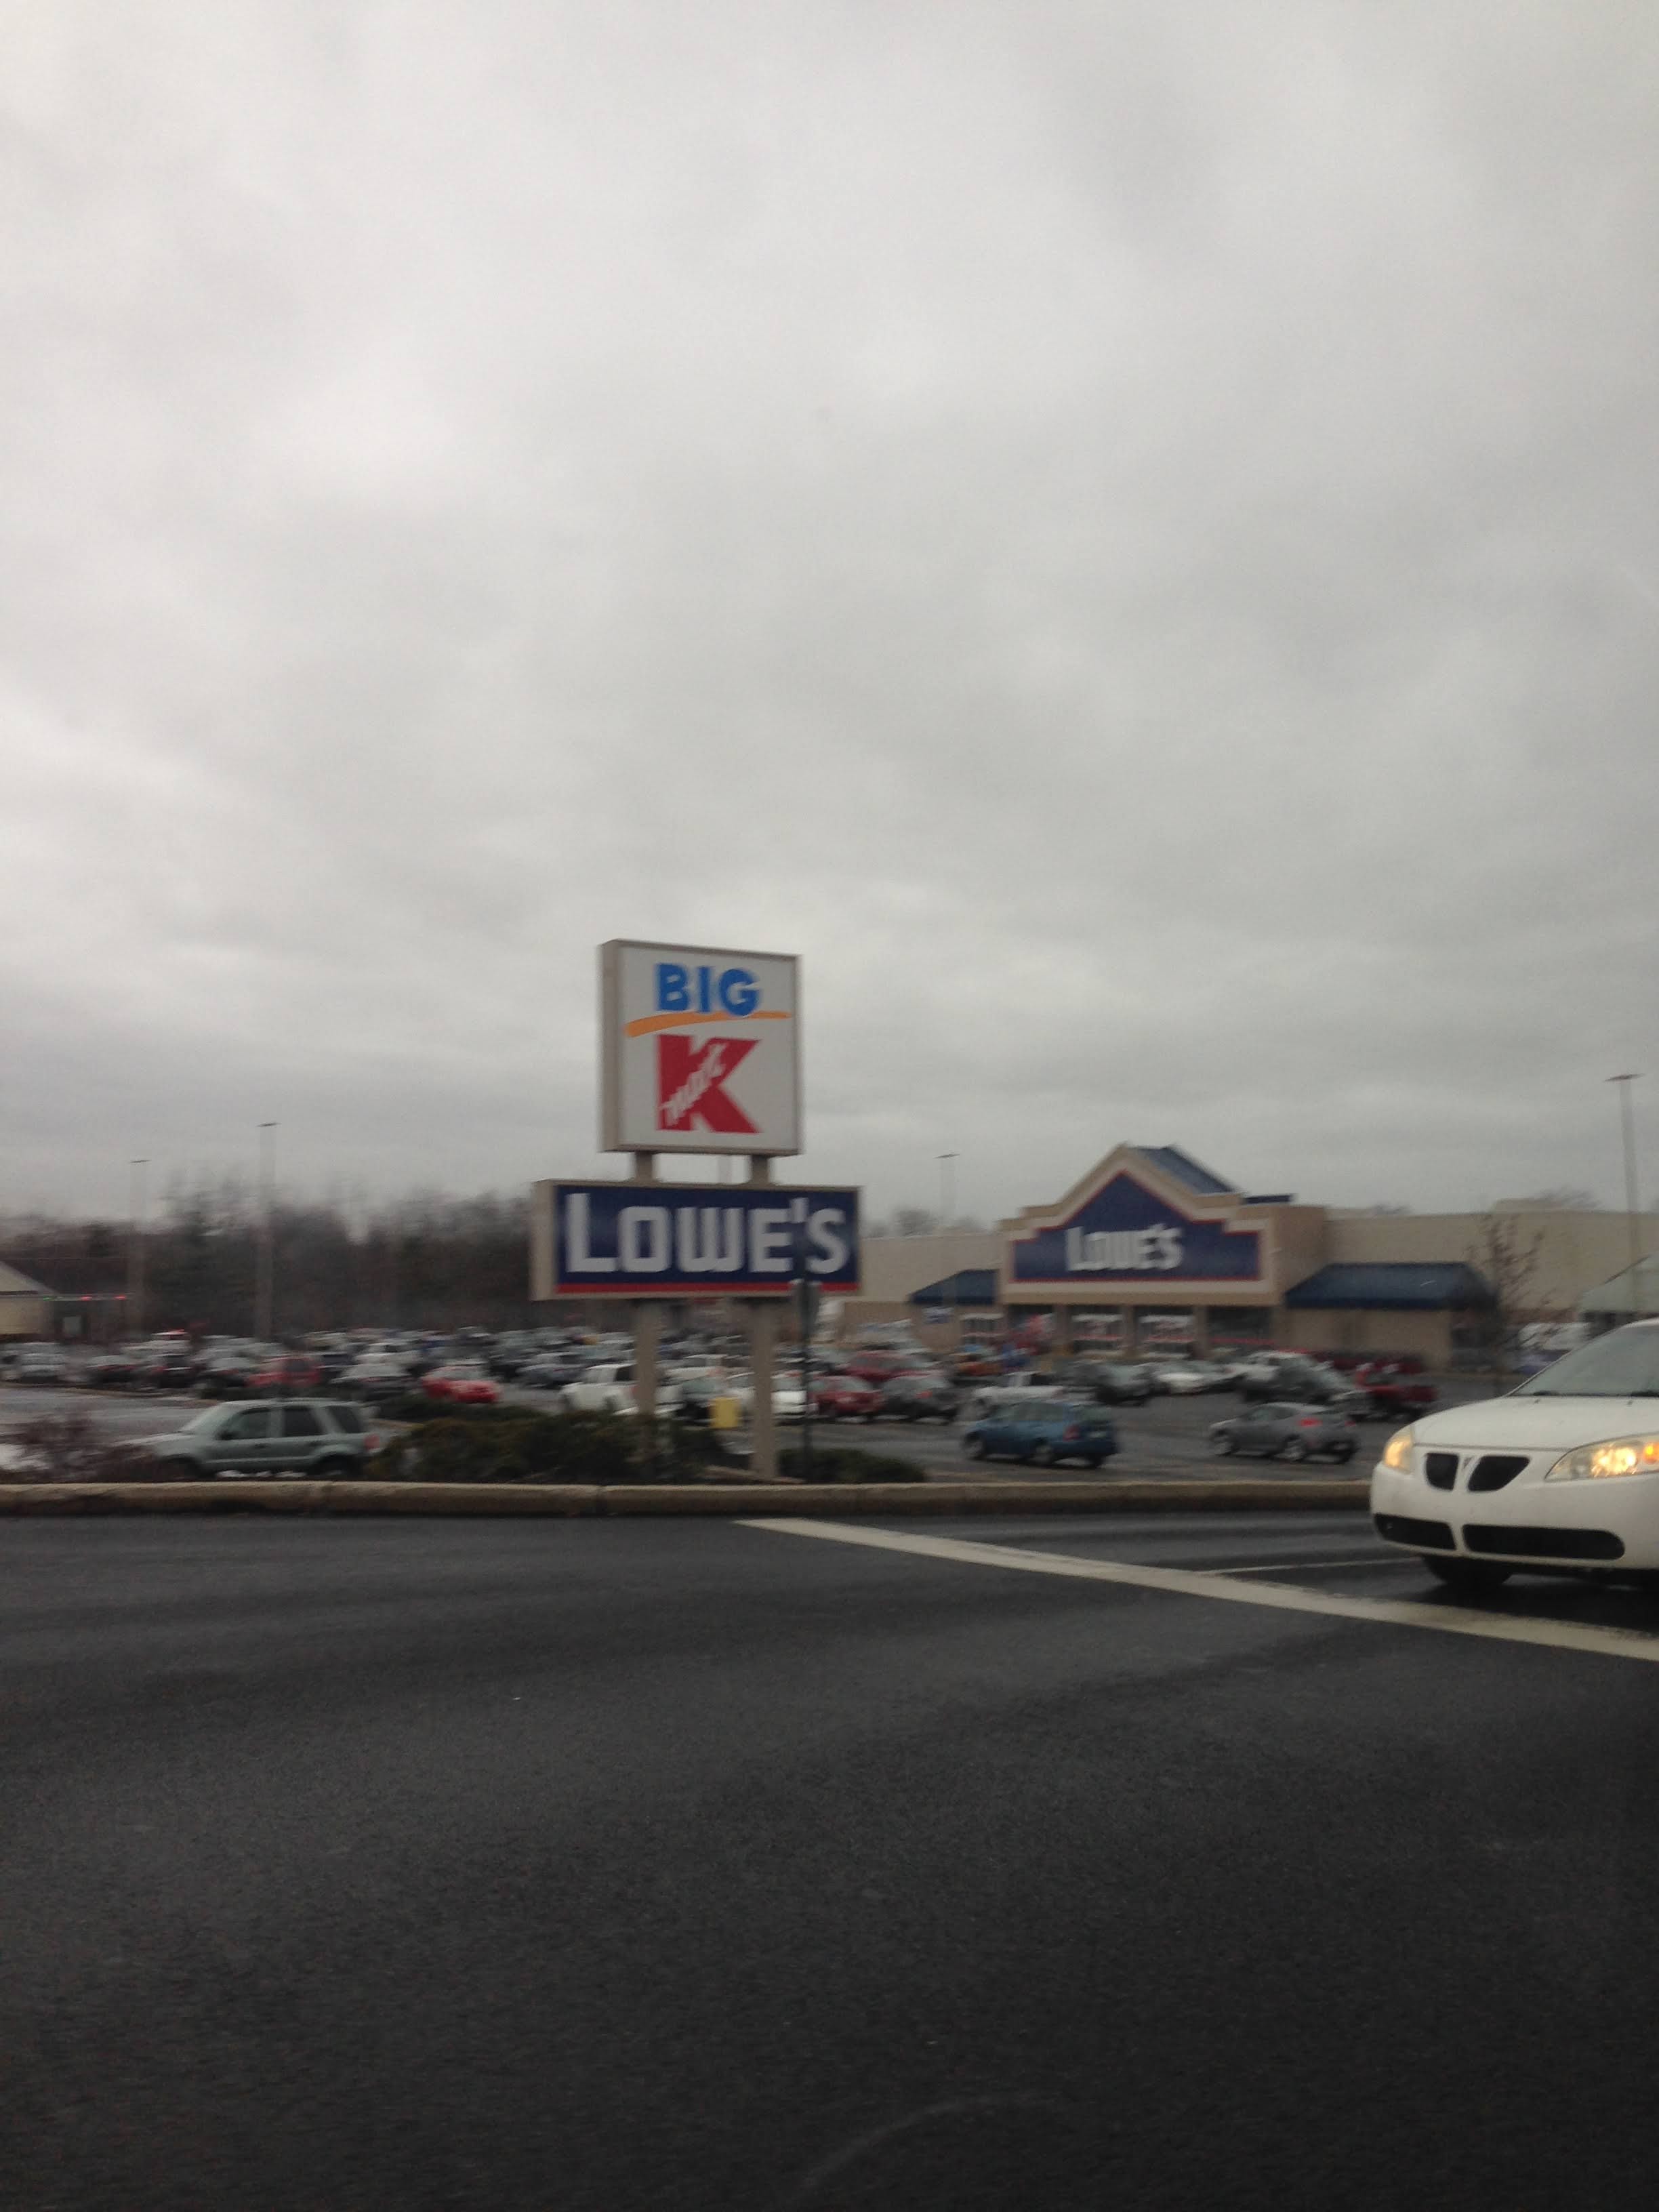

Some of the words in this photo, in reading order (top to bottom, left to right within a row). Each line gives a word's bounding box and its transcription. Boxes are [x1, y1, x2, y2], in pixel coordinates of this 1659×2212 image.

[655, 963, 760, 1017] BIG
[657, 1034, 761, 1133] K
[565, 1192, 848, 1274] LOWE'S
